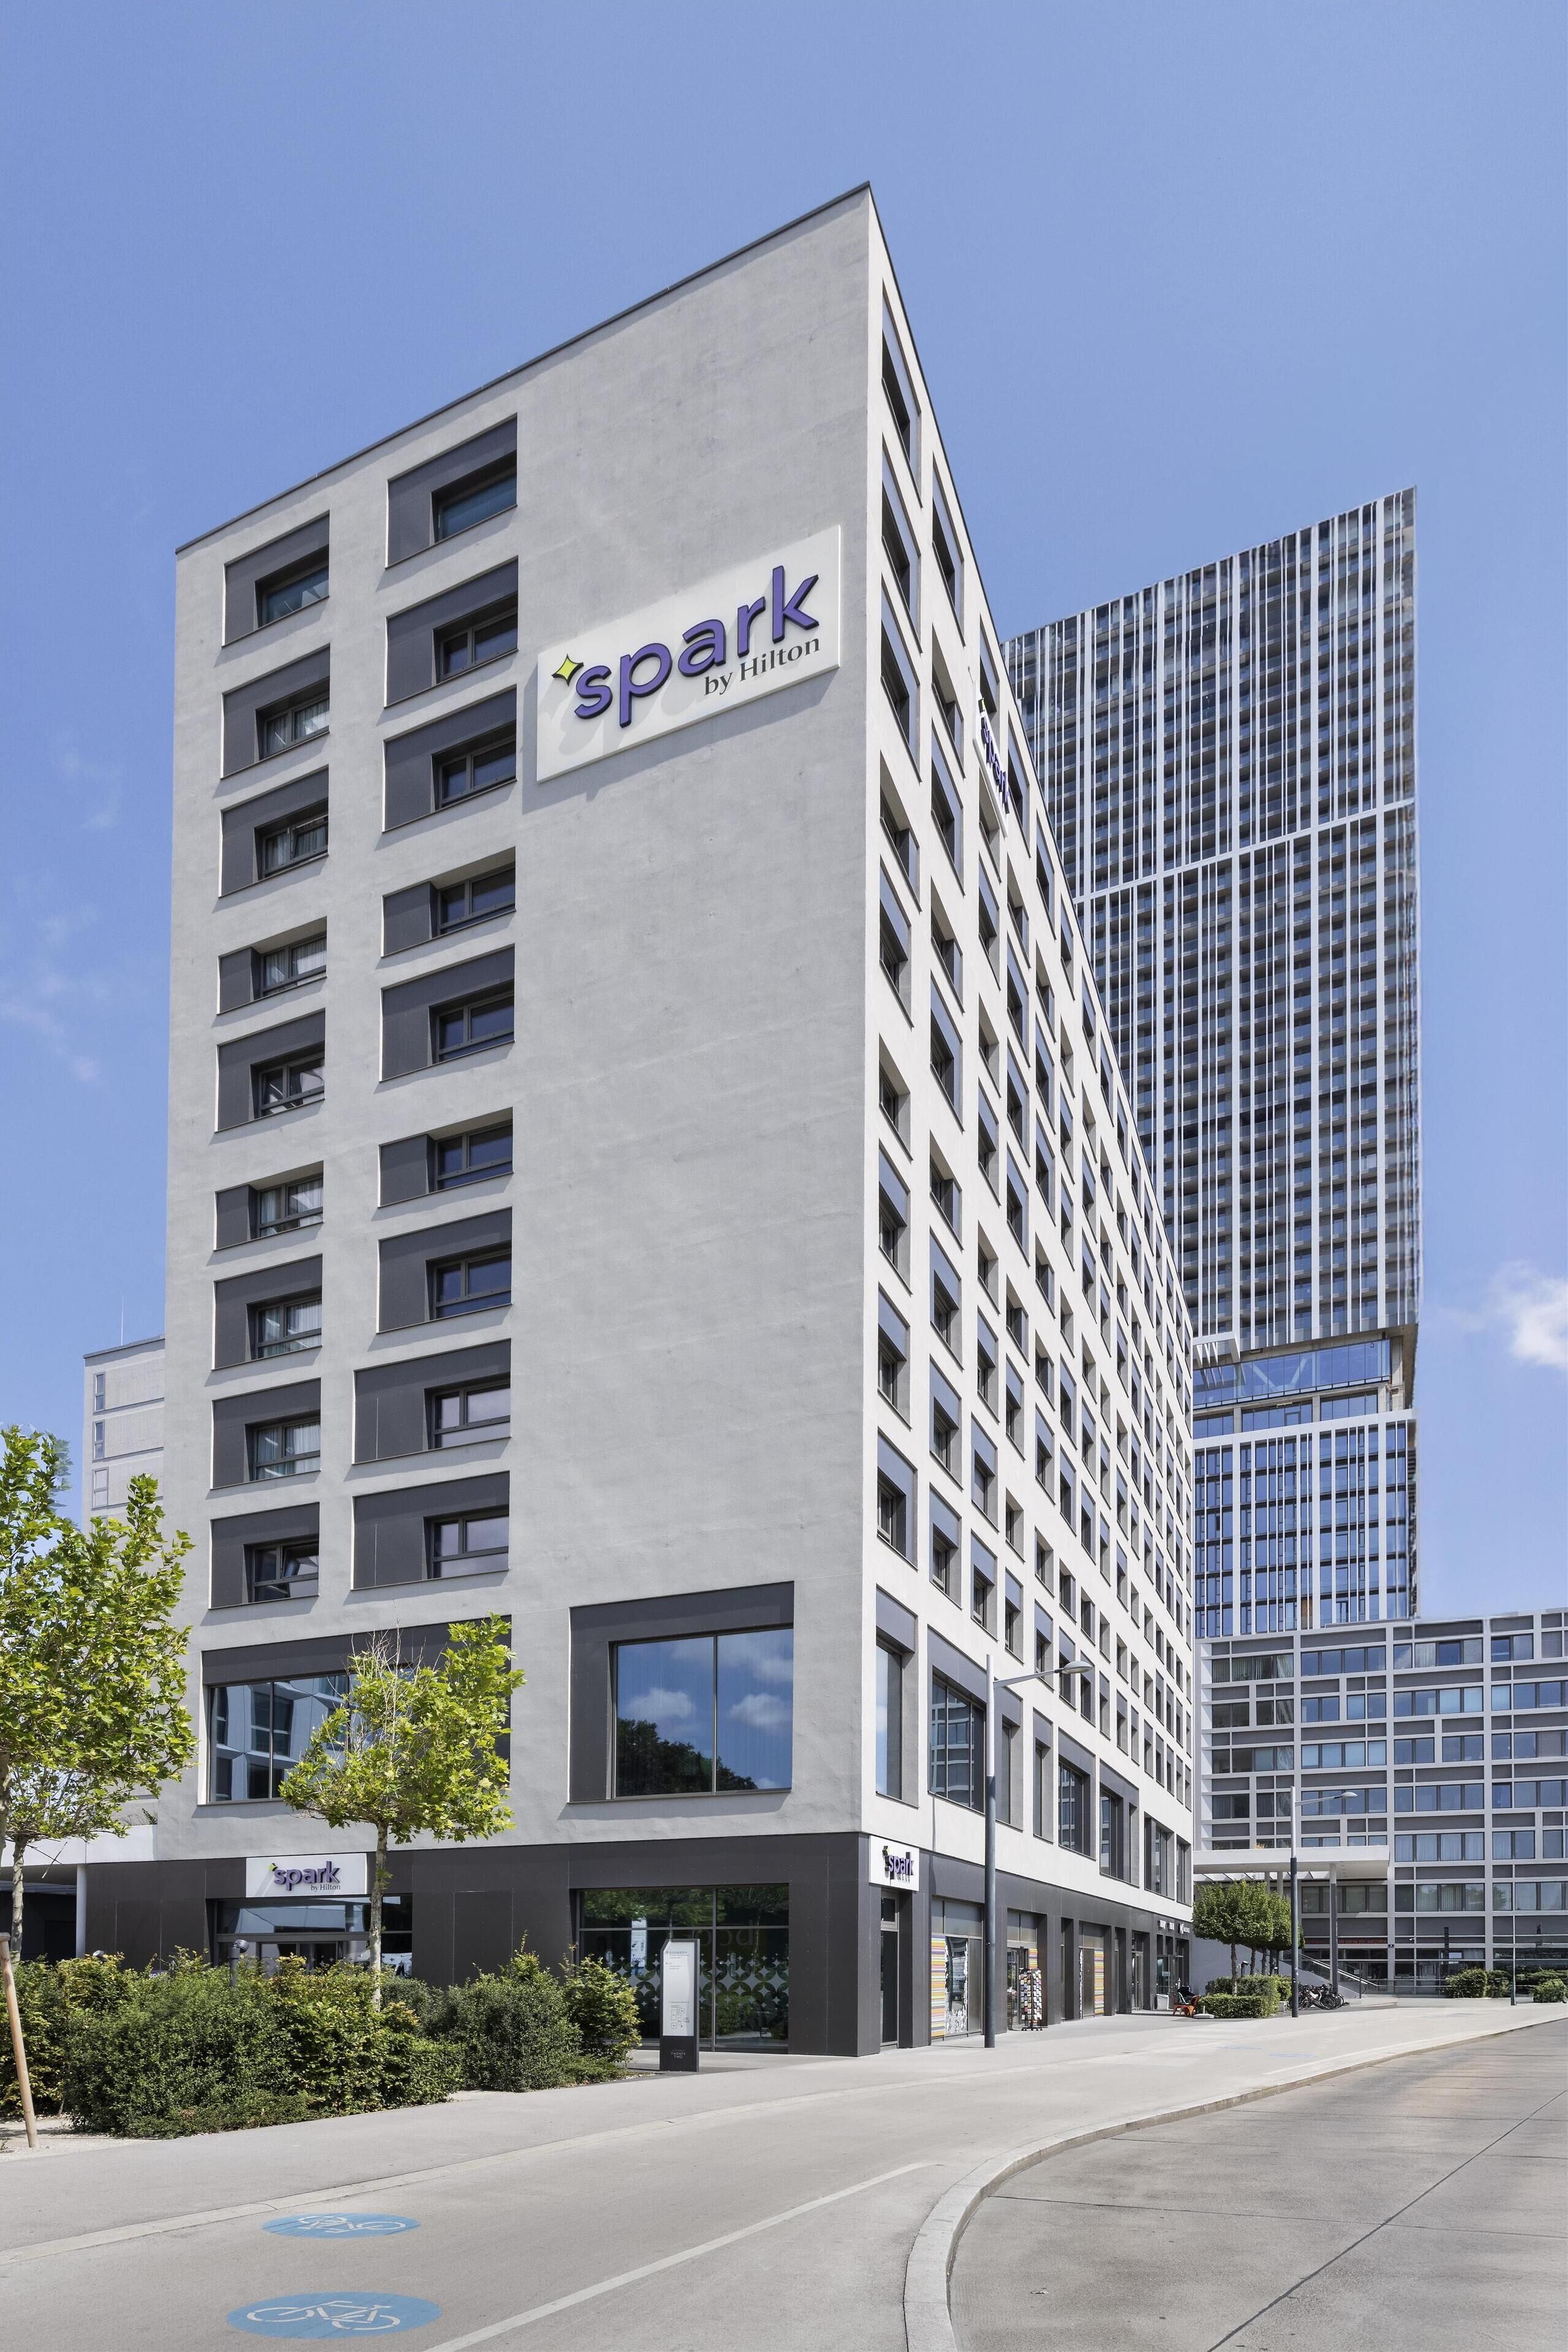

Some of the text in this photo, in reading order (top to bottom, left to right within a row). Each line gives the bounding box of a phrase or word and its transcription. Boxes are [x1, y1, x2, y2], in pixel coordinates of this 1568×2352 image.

[574, 565, 819, 728] spark
[704, 638, 820, 696] by Hilton
[274, 1861, 340, 1892] spark
[887, 1852, 914, 1880] spark
